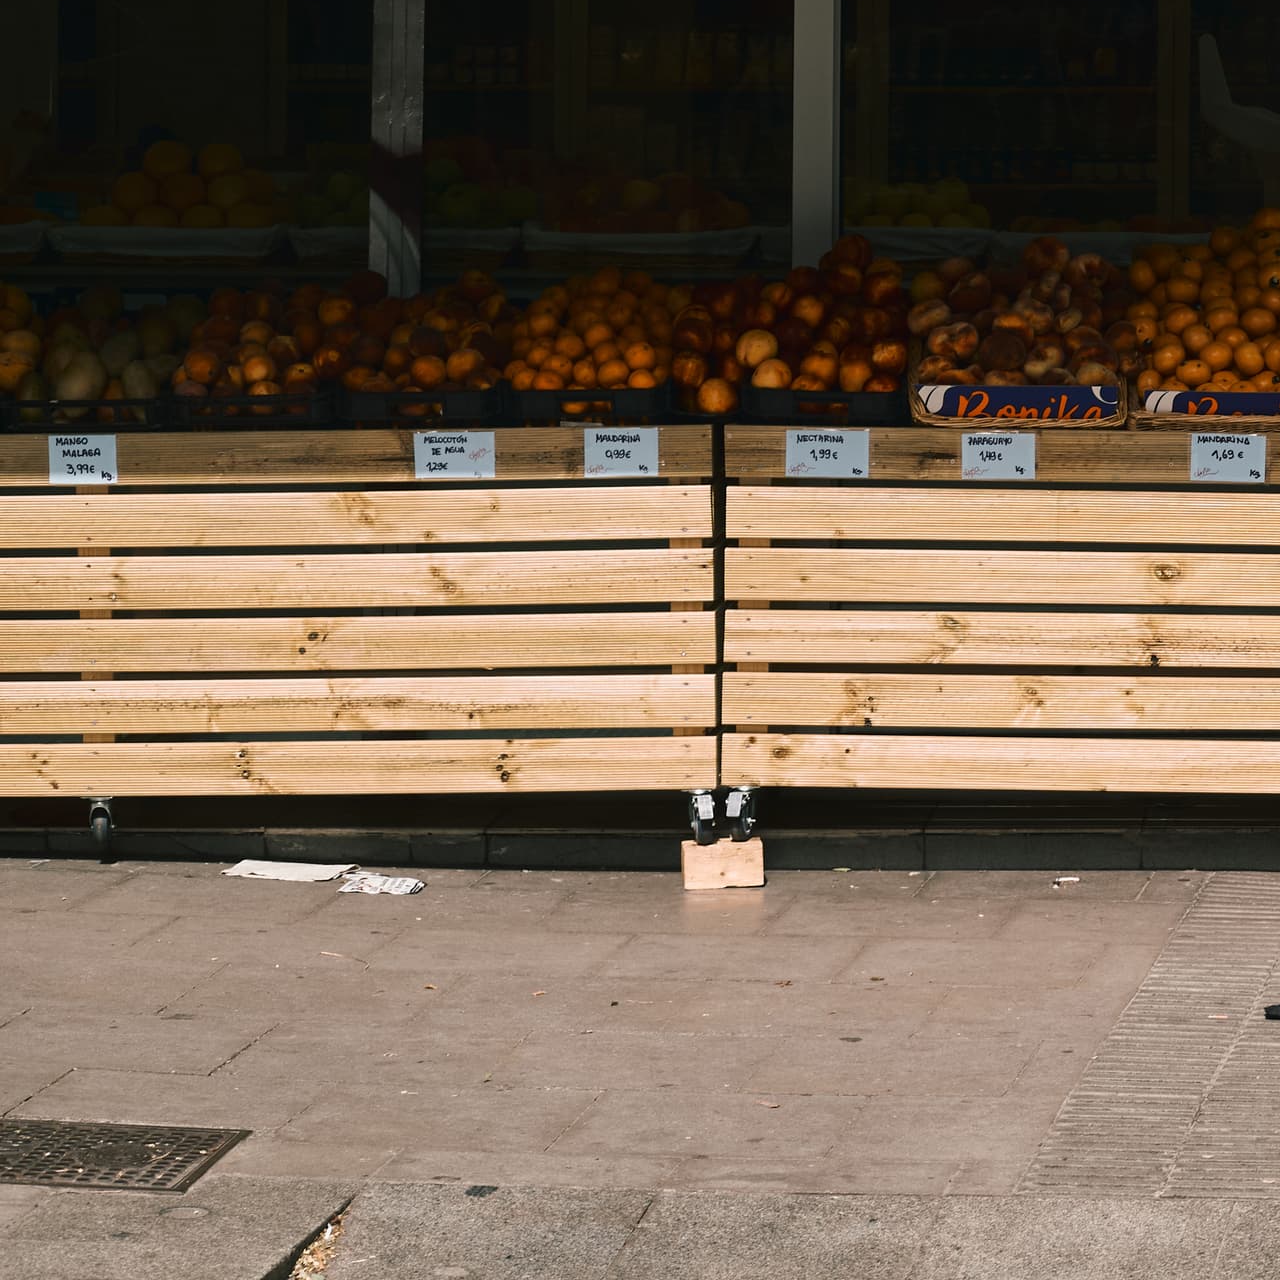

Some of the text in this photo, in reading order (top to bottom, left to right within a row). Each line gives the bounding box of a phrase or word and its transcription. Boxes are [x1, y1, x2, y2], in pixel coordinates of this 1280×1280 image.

[55, 437, 88, 446] MANGO
[796, 434, 845, 444] NECTARINA
[62, 448, 101, 458] MALAGA
[431, 447, 441, 456] DE
[444, 446, 465, 455] AGUA
